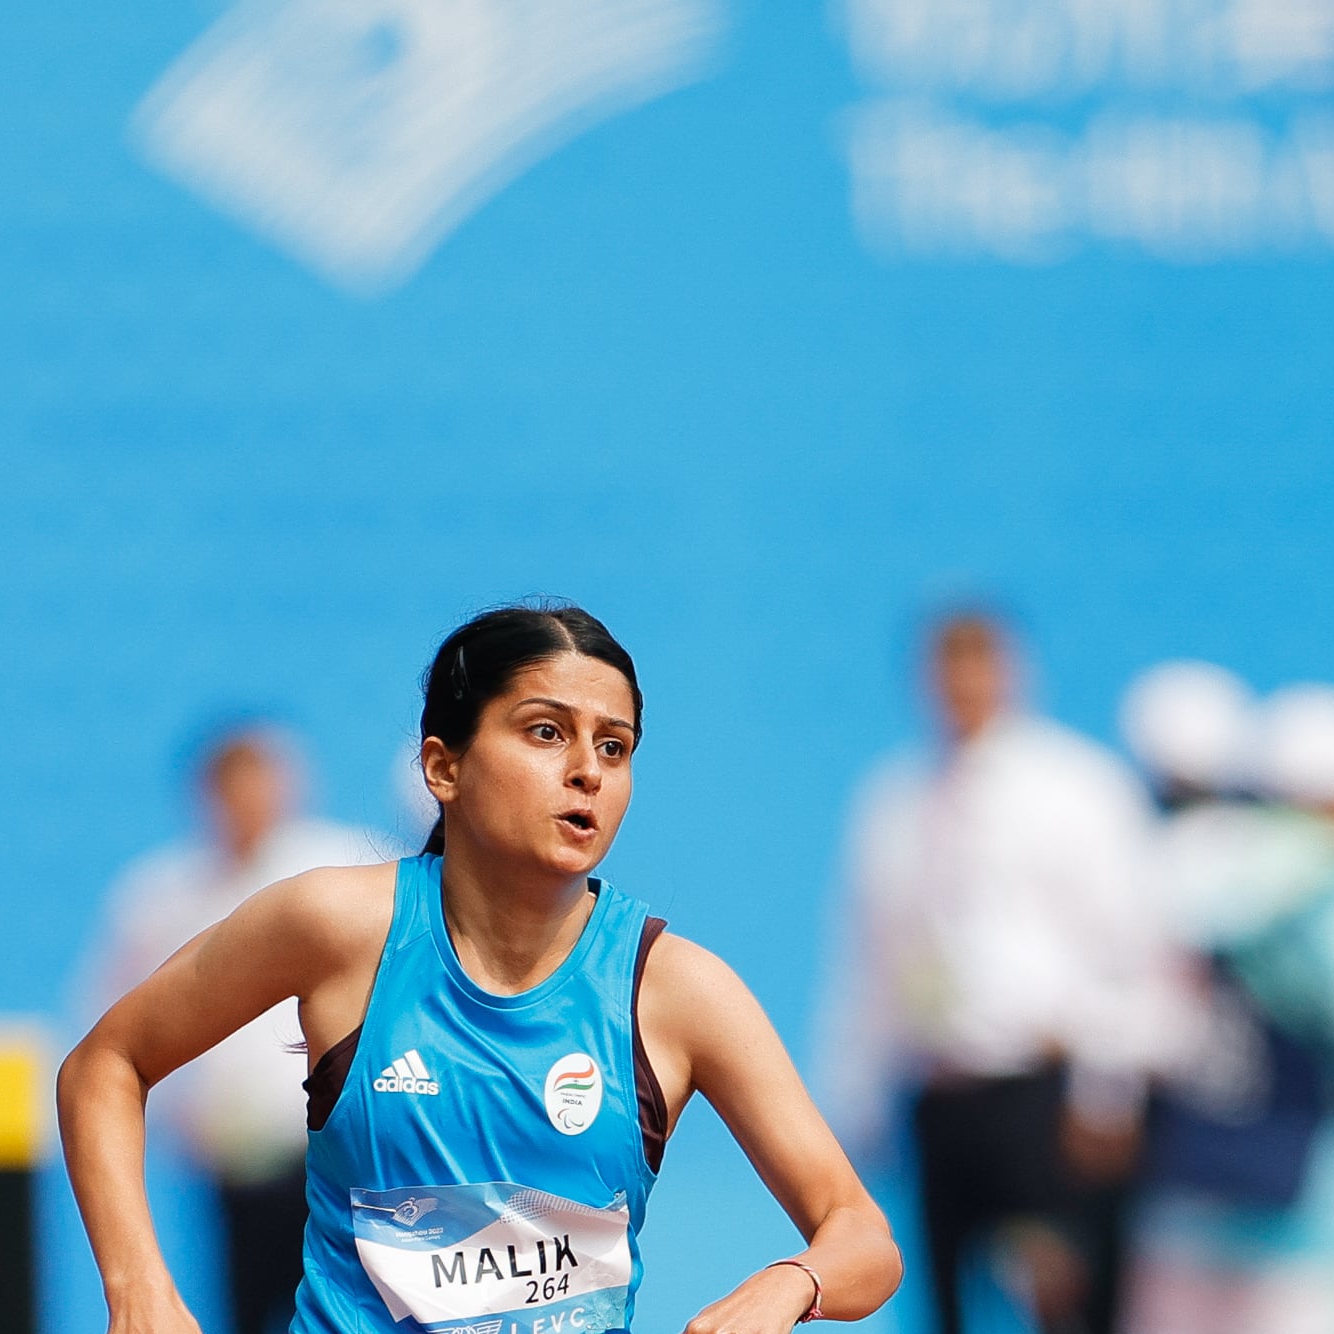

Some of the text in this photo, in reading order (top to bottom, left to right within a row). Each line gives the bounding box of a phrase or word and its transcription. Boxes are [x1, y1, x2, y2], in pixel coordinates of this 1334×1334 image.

[373, 1076, 440, 1096] adidas
[431, 1233, 579, 1288] MALIK
[525, 1272, 570, 1304] 264
